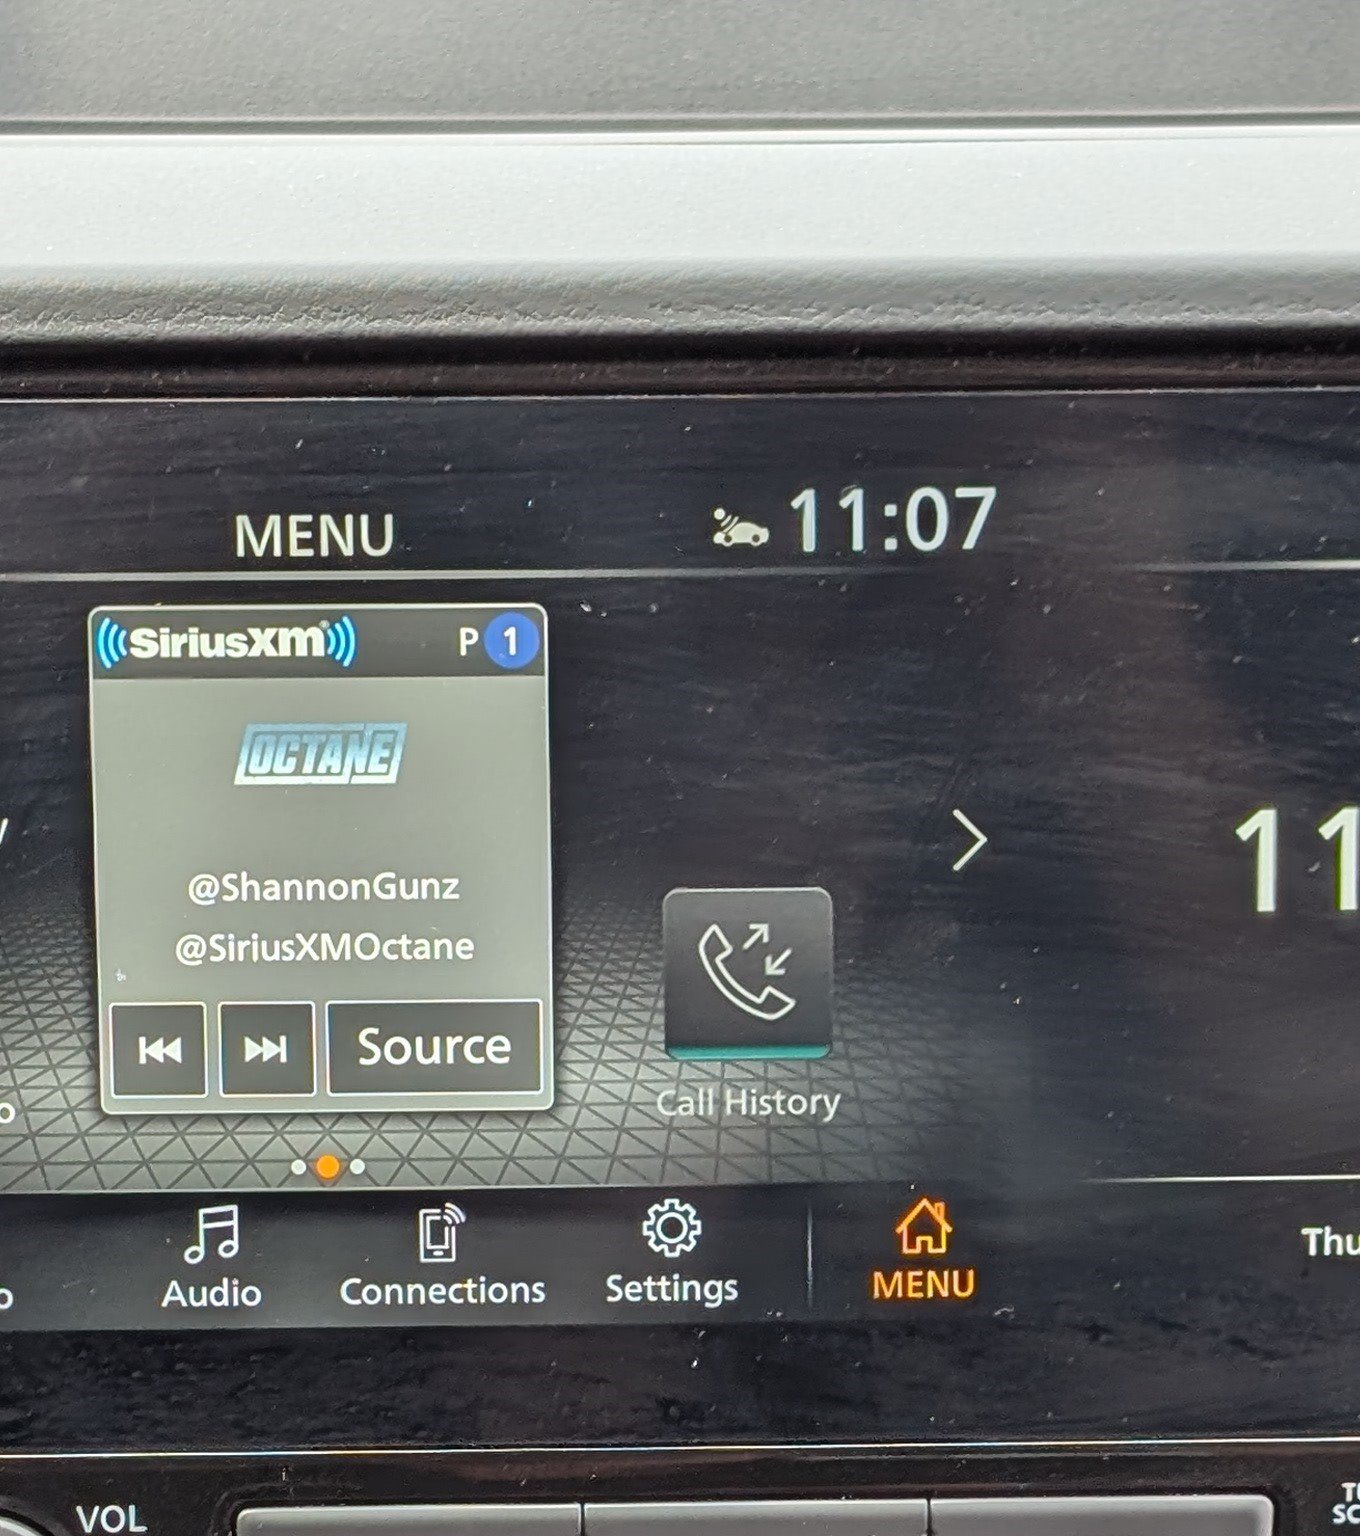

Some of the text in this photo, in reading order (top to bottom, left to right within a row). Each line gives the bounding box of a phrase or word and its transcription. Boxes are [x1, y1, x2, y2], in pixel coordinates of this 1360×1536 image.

[235, 513, 394, 558] MENU
[790, 485, 998, 553] 11:07
[459, 626, 519, 656] P 1
[246, 732, 394, 775] OCTANE
[187, 872, 461, 906] @ShannonGunz
[174, 931, 476, 965] @SiriusXMOctane
[357, 1027, 513, 1066] Source
[655, 1087, 842, 1123] Call History
[160, 1279, 263, 1308] Audio
[339, 1276, 547, 1307] Connections
[605, 1272, 739, 1309] Settings
[872, 1268, 976, 1300] MENU
[75, 1504, 149, 1534] VOL
